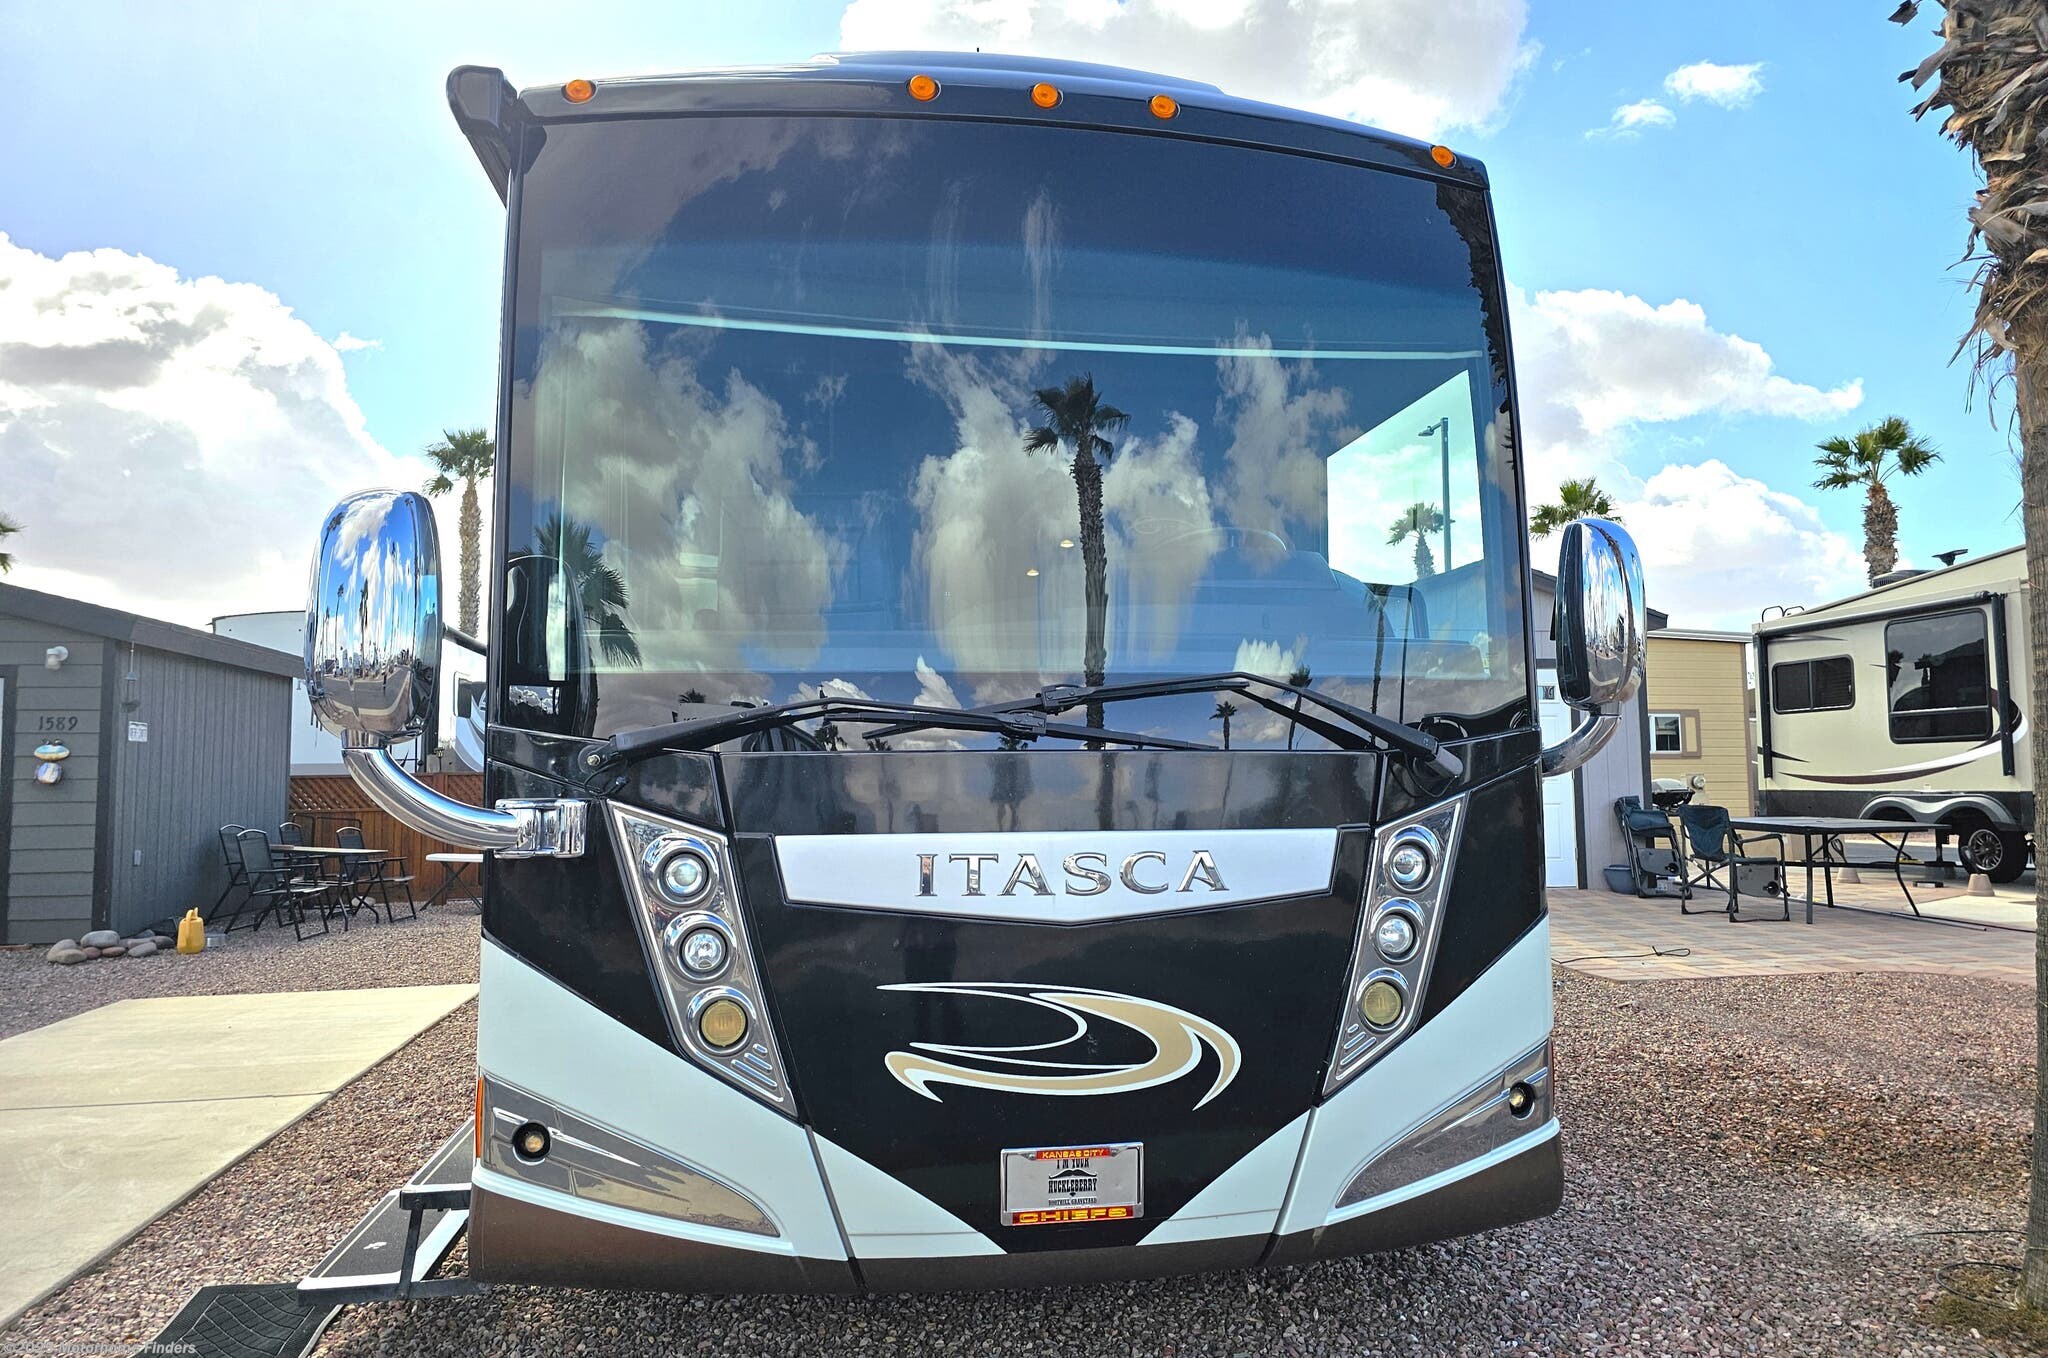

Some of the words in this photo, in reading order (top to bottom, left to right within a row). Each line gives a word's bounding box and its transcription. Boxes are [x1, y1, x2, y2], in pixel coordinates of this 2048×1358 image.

[39, 716, 78, 731] 1589
[914, 850, 1230, 897] ITASCA
[1042, 1150, 1082, 1159] KANSAS
[1084, 1149, 1105, 1157] CITY
[1056, 1159, 1069, 1169] IM
[1048, 1178, 1097, 1194] HUCKLEBERRY
[1019, 1207, 1127, 1223] CHIEFS
